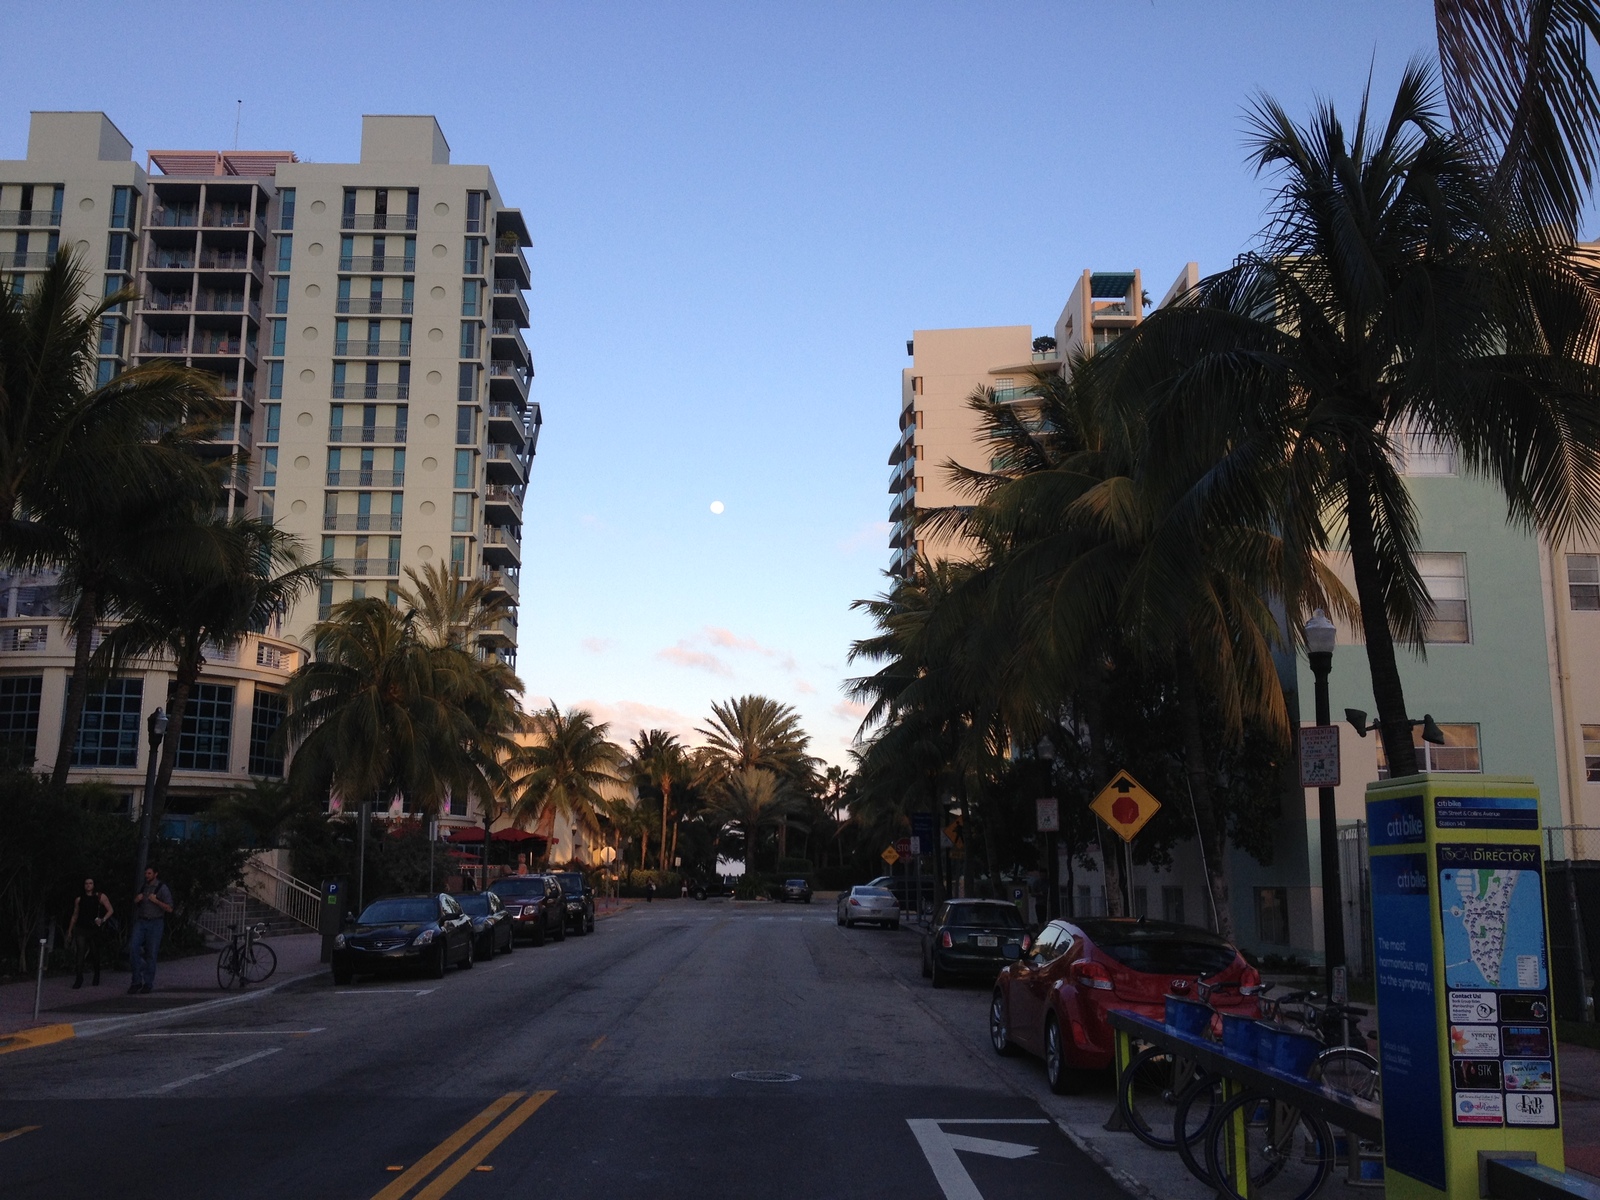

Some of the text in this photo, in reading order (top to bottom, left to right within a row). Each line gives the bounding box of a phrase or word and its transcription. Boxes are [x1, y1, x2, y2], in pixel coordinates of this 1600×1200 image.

[896, 844, 910, 852] STO
[1474, 851, 1535, 862] DIRECTORY
[1378, 937, 1407, 952] The most
[1378, 955, 1429, 976] harmonious way
[1380, 973, 1433, 995] to the symphony.
[1477, 1064, 1493, 1076] STK
